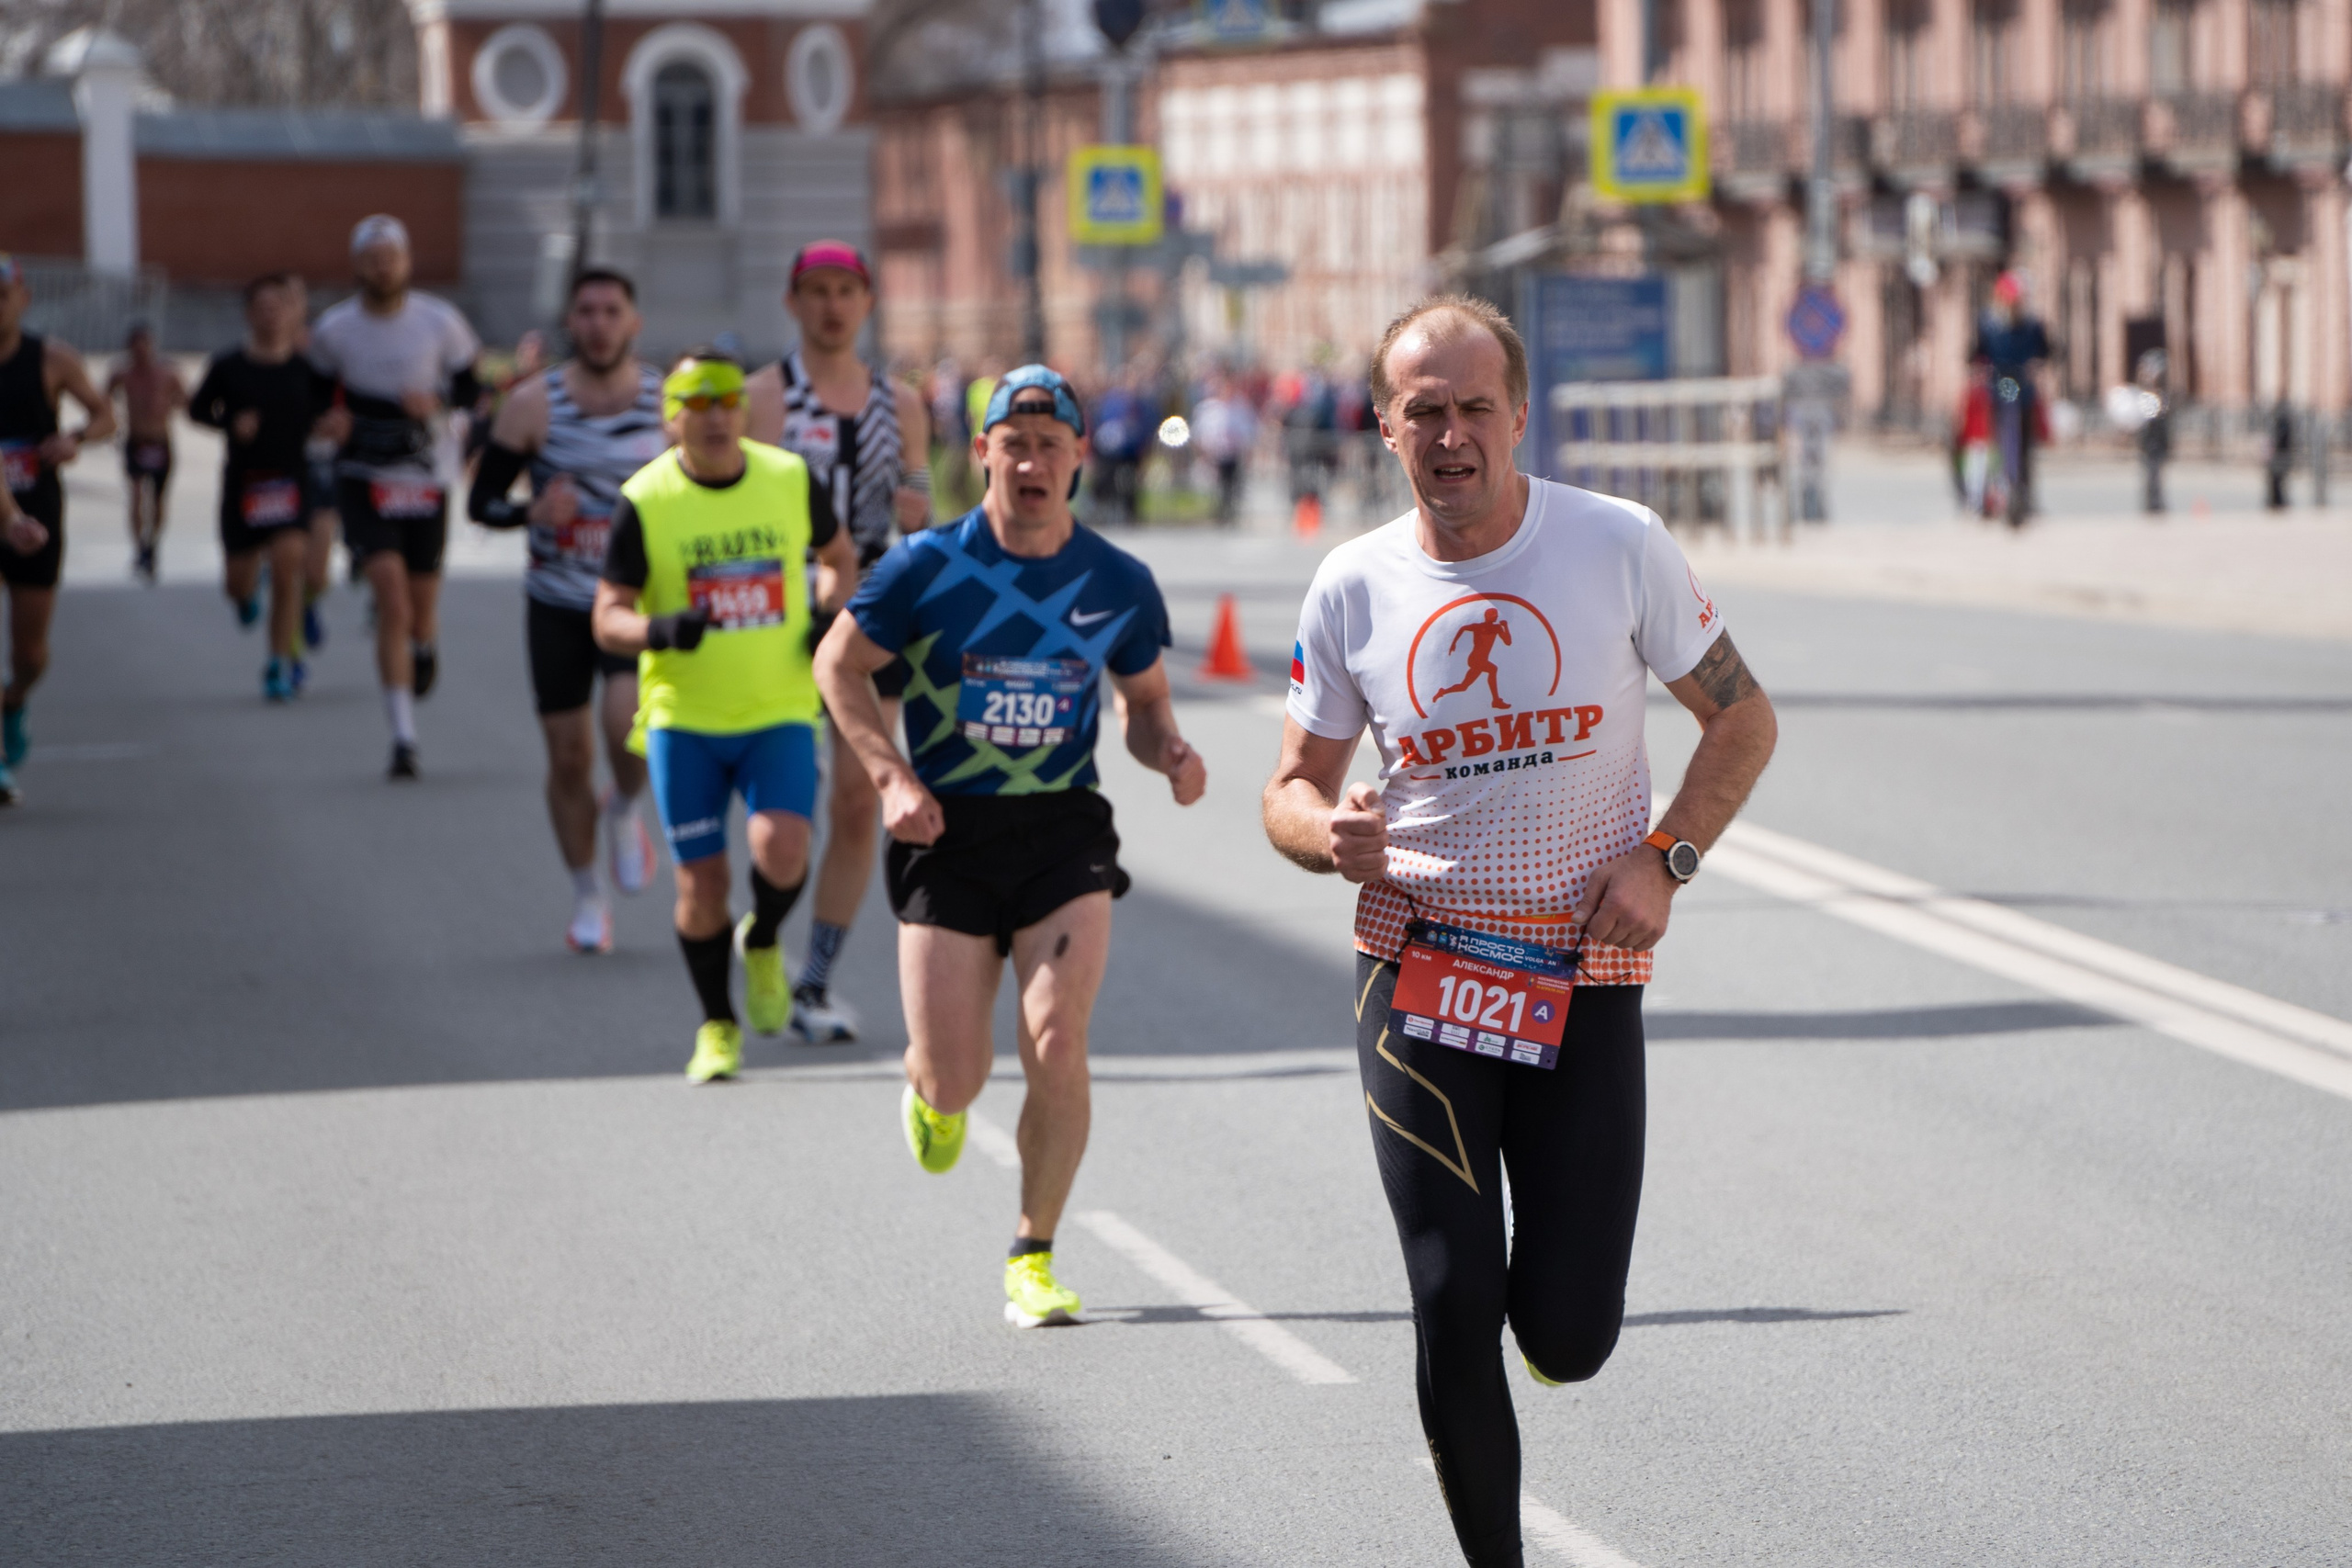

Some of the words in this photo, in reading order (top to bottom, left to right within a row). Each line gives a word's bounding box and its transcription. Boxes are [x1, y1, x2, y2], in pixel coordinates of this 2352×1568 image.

[982, 691, 1056, 727] 2130
[1397, 705, 1604, 769] АРБИТР
[1444, 750, 1555, 780] команда
[1411, 950, 1420, 958] 10
[1457, 942, 1525, 964] КОСМОС
[1470, 937, 1525, 955] ПРОСТО
[1453, 959, 1515, 980] АЛЕКСАНДР
[1439, 976, 1527, 1032] 1021
